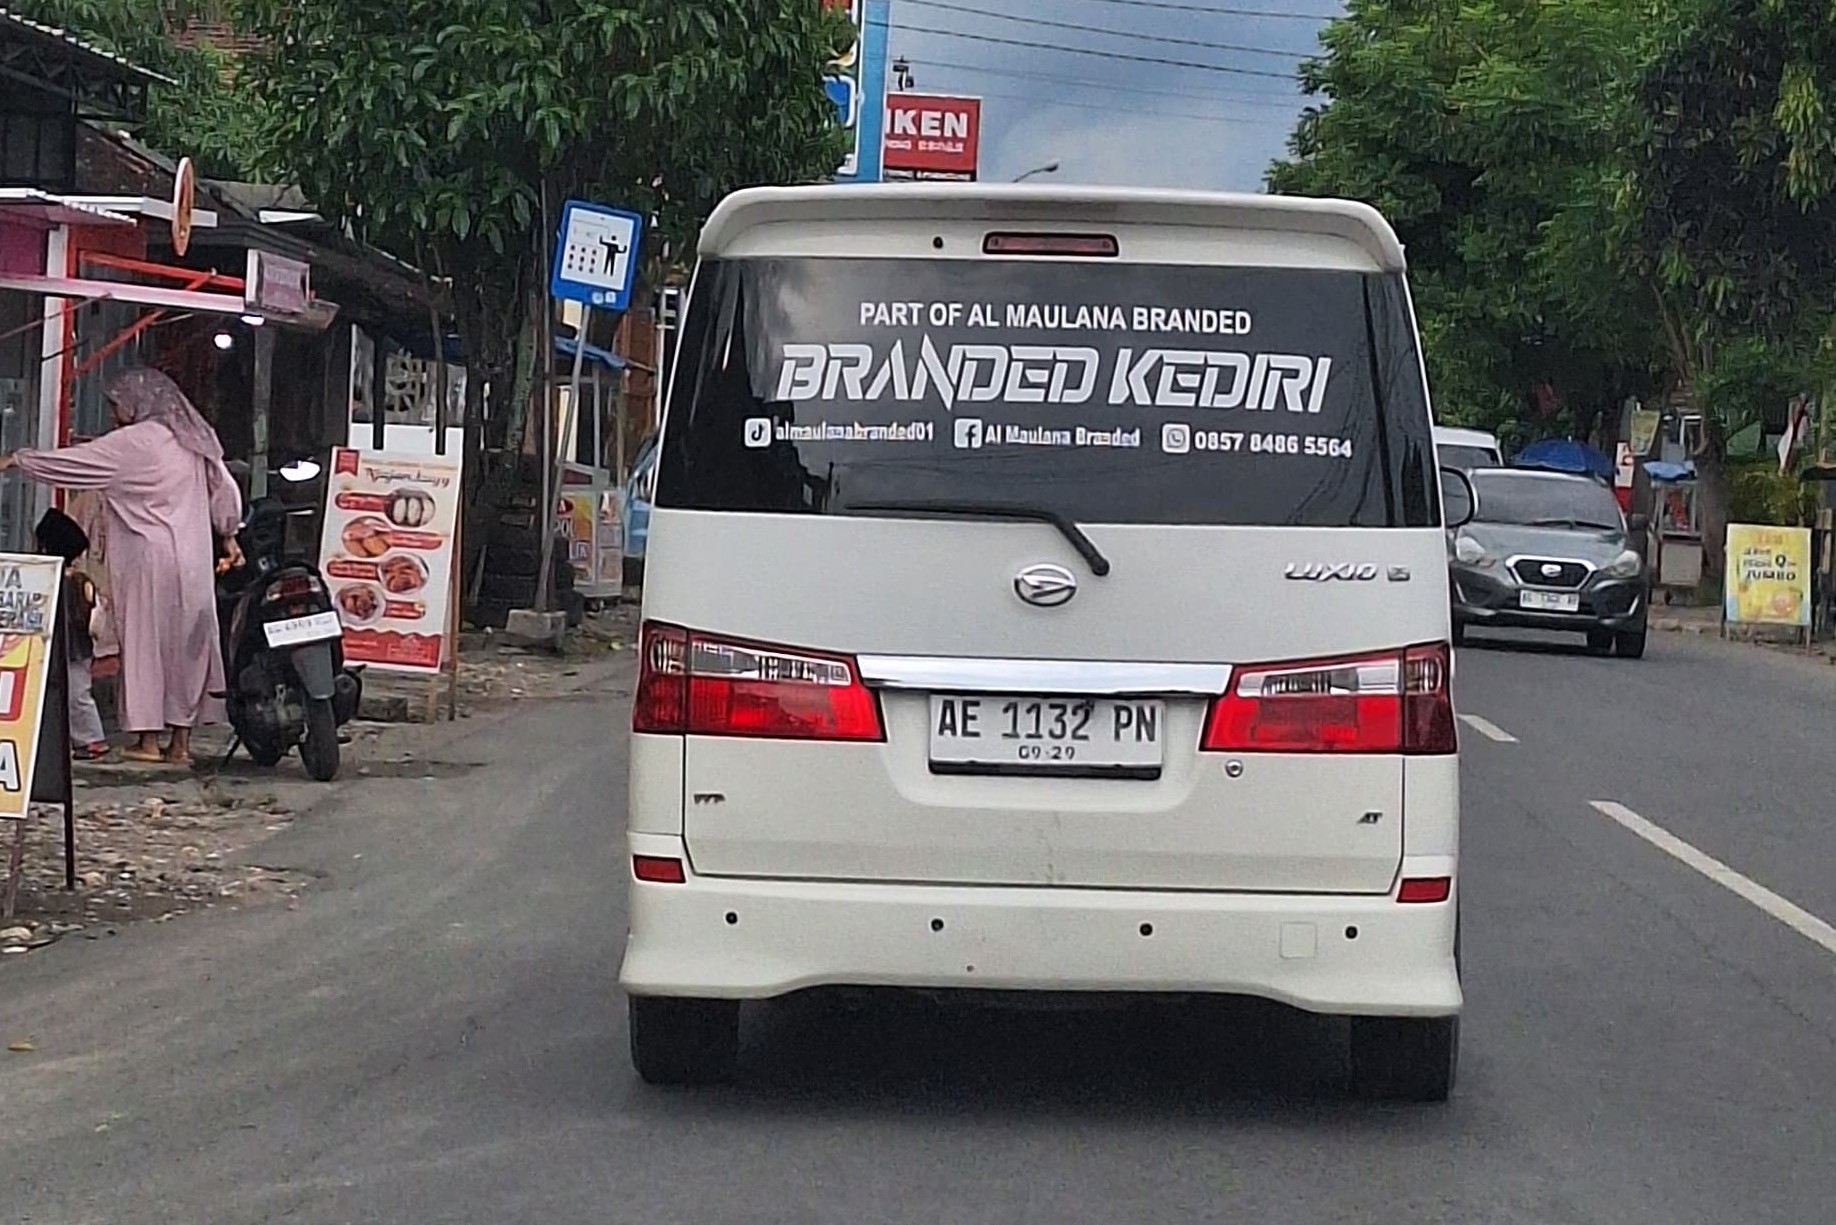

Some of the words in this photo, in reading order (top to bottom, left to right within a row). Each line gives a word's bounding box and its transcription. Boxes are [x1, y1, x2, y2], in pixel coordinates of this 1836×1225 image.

[860, 302, 924, 326] PART
[929, 303, 963, 326] OF
[967, 304, 1000, 327] AL
[1006, 304, 1127, 330] MAULANA
[1132, 306, 1251, 334] BRANDED
[776, 333, 1099, 411] BRANDED
[1108, 348, 1332, 413] KEDIRI
[985, 425, 1001, 444] Al
[1005, 425, 1071, 445] Maulana
[1075, 427, 1140, 447] Branded
[1195, 431, 1244, 450] 0857
[1250, 434, 1298, 453] 8486
[1304, 436, 1352, 457] 5564
[1285, 562, 1377, 581] LUXIO
[938, 699, 981, 737] AE
[1001, 701, 1092, 741] 1132
[1114, 704, 1156, 742] PN
